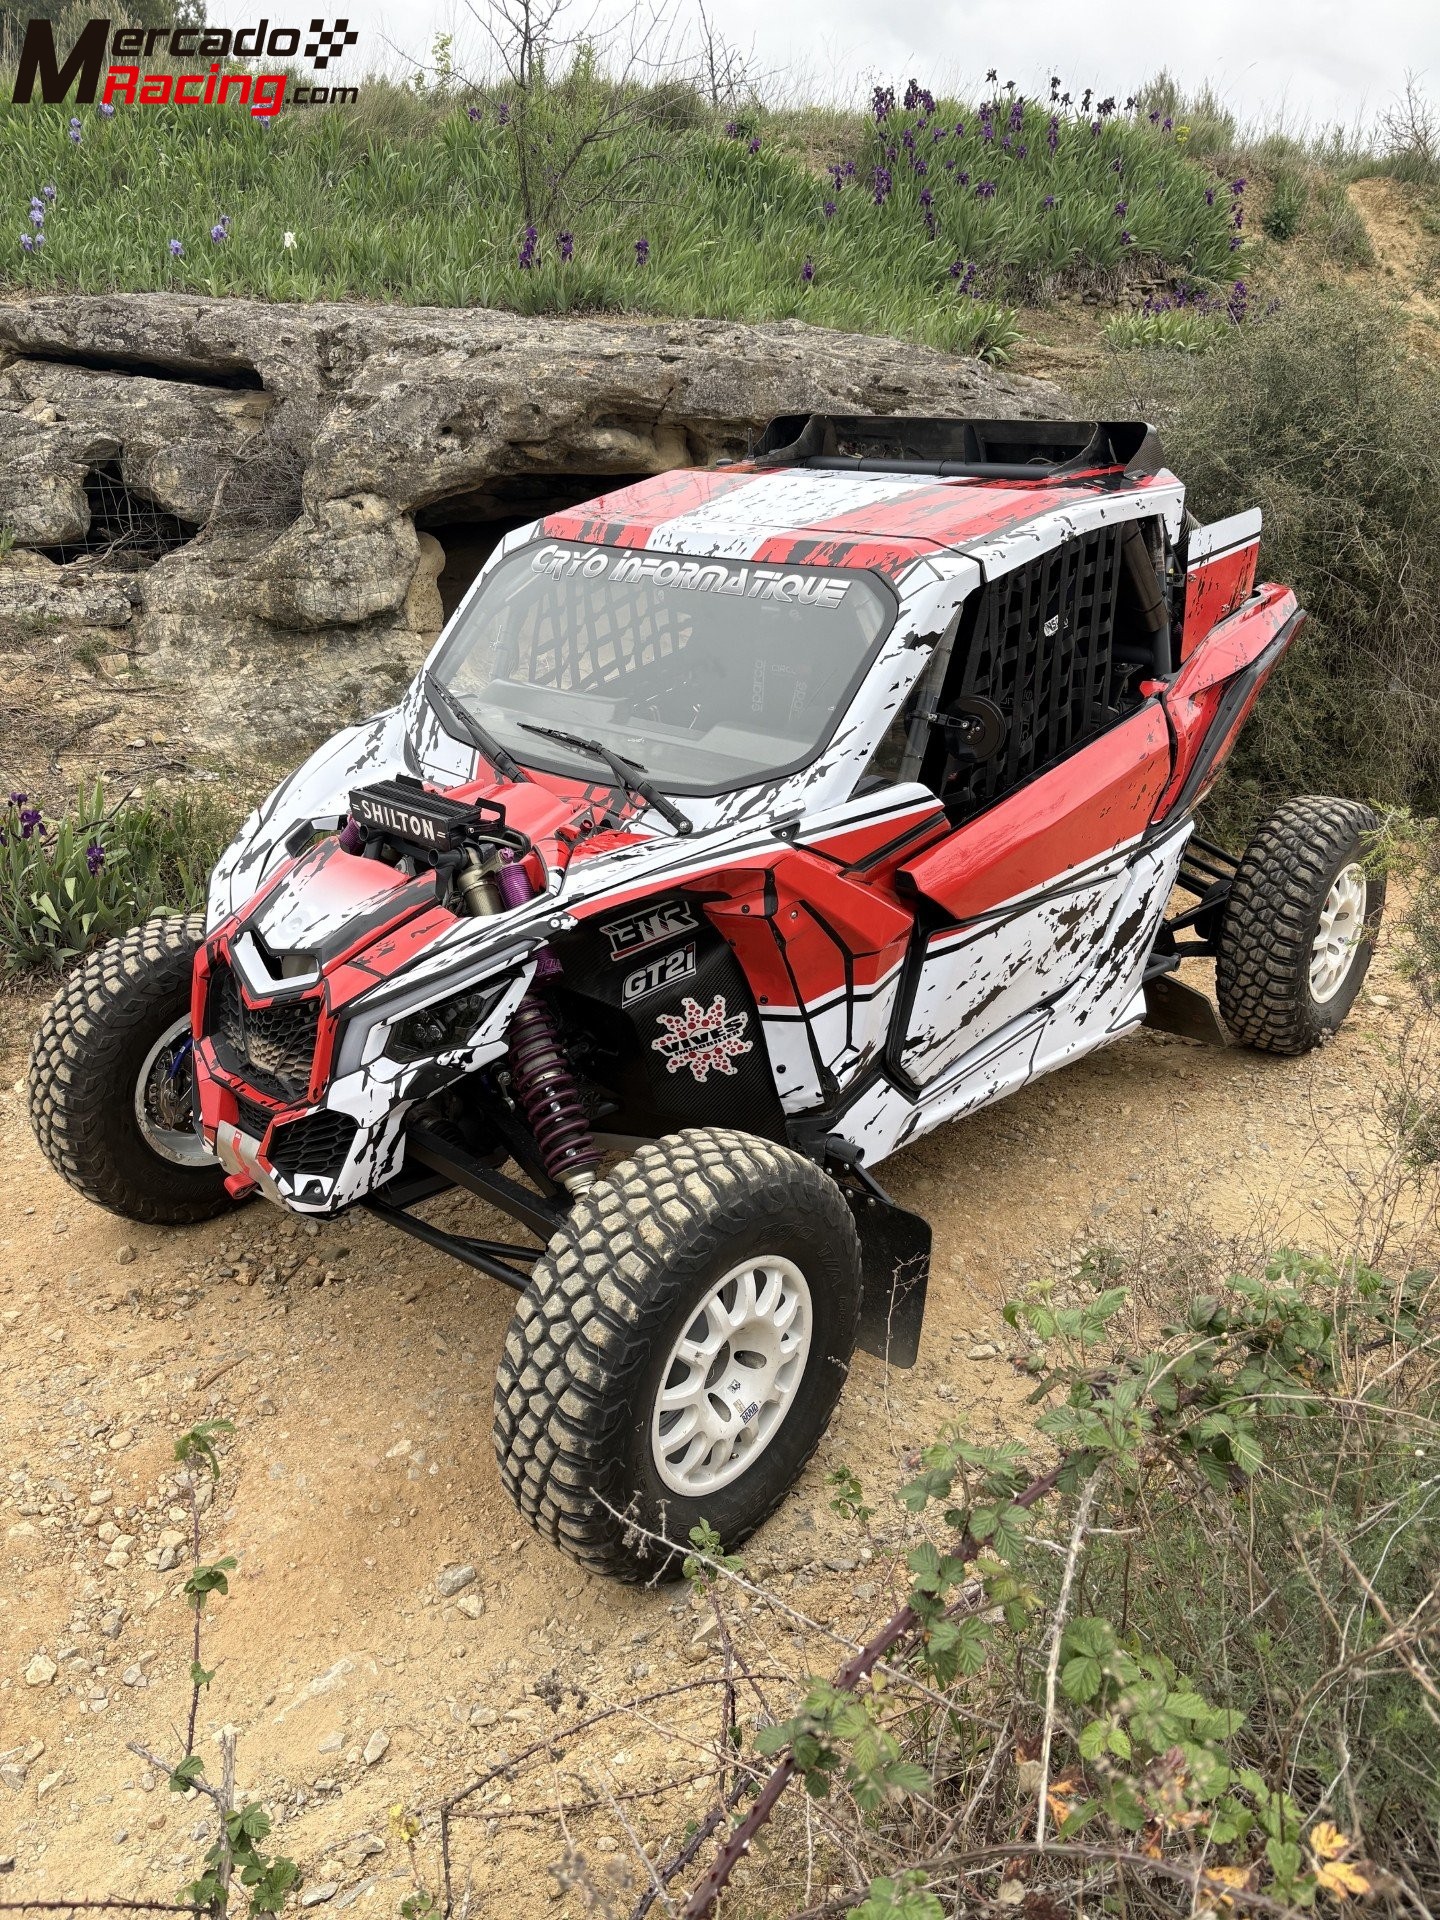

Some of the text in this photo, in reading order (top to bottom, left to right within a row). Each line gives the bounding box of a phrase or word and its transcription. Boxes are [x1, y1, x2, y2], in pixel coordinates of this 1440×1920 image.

[531, 545, 609, 581] CRYO
[361, 799, 436, 841] SHILTON
[660, 1018, 743, 1054] VIVES
